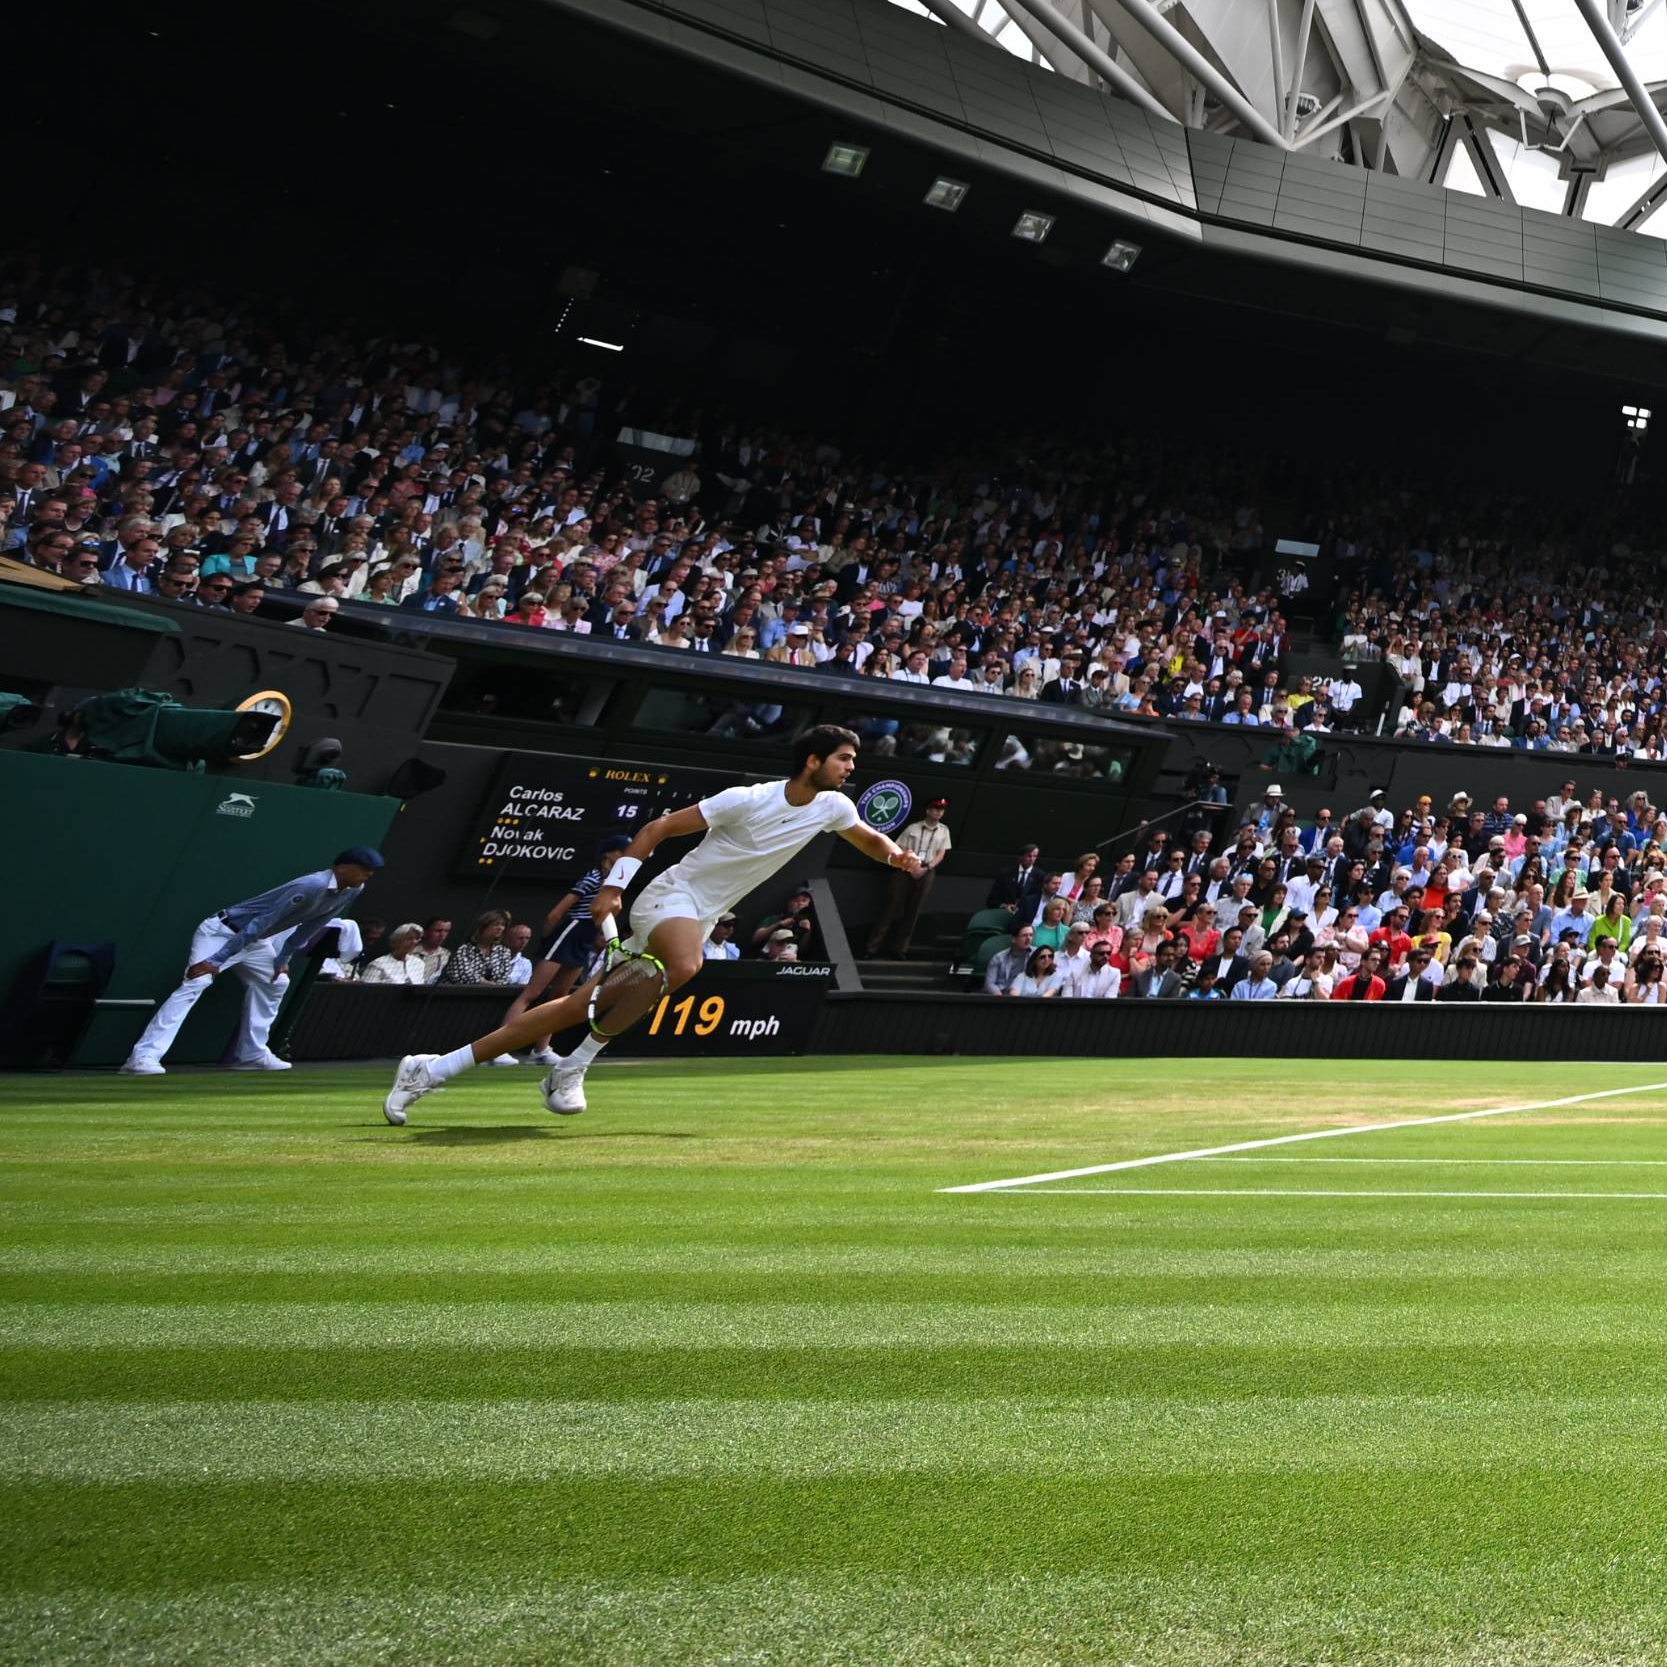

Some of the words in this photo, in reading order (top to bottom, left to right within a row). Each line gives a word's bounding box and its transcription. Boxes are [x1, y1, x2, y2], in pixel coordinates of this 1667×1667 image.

[605, 770, 651, 783] ROLEX
[509, 785, 564, 802] Carlos
[623, 787, 648, 795] POINTS
[500, 802, 585, 821] ALCARAZ
[617, 805, 638, 818] 15
[482, 842, 575, 861] DJOKOVIC
[776, 966, 831, 976] JAGUAR
[648, 994, 725, 1036] 119
[729, 1015, 780, 1040] mph
